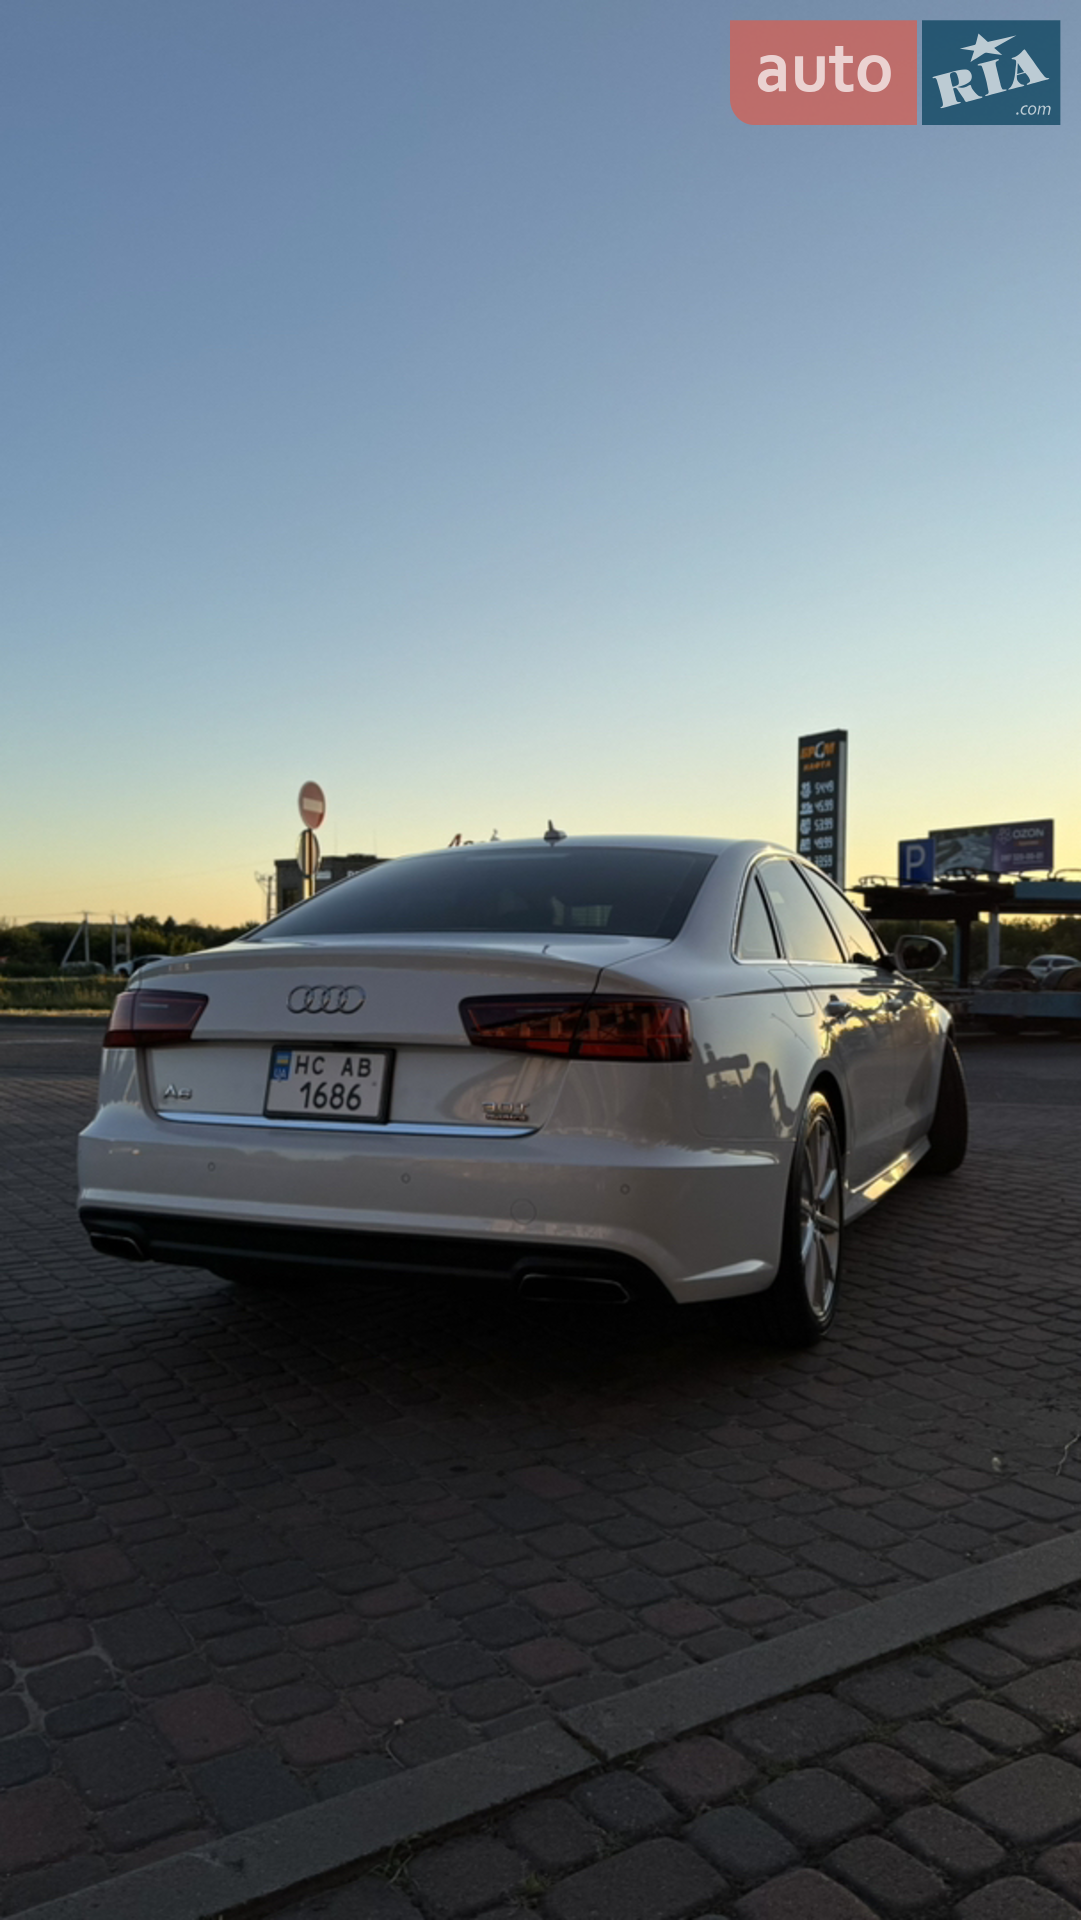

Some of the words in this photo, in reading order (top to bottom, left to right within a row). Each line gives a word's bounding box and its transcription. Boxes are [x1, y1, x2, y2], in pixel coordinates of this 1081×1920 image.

[1012, 828, 1045, 840] OZON
[905, 844, 926, 880] P
[294, 1055, 326, 1076] HC
[340, 1057, 372, 1078] AB
[300, 1081, 362, 1112] 1686
